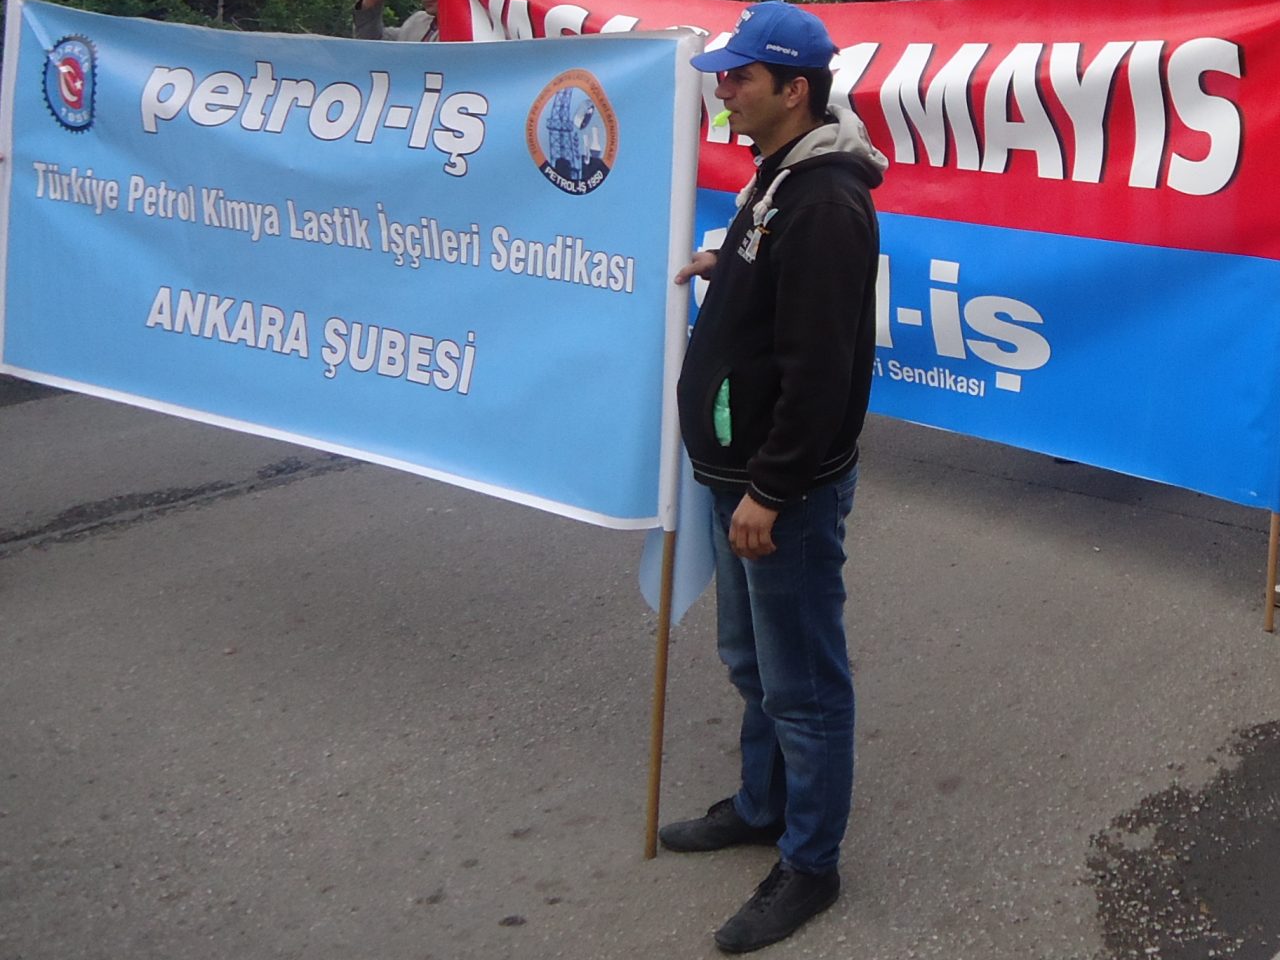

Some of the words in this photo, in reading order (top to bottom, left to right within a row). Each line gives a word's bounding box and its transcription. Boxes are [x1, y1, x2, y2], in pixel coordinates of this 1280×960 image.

[141, 61, 489, 177] petrol-iş
[879, 38, 1242, 195] MAYIS
[33, 161, 119, 215] Türkiye
[127, 174, 196, 223] Petrol
[201, 187, 280, 241] Kimya
[285, 199, 372, 250] Lastik
[376, 202, 481, 269] İşçileri
[490, 226, 636, 293] Sendikası
[146, 286, 309, 358] ANKARA
[321, 316, 476, 395] ŞUBESİ
[888, 360, 985, 397] Sendikası
